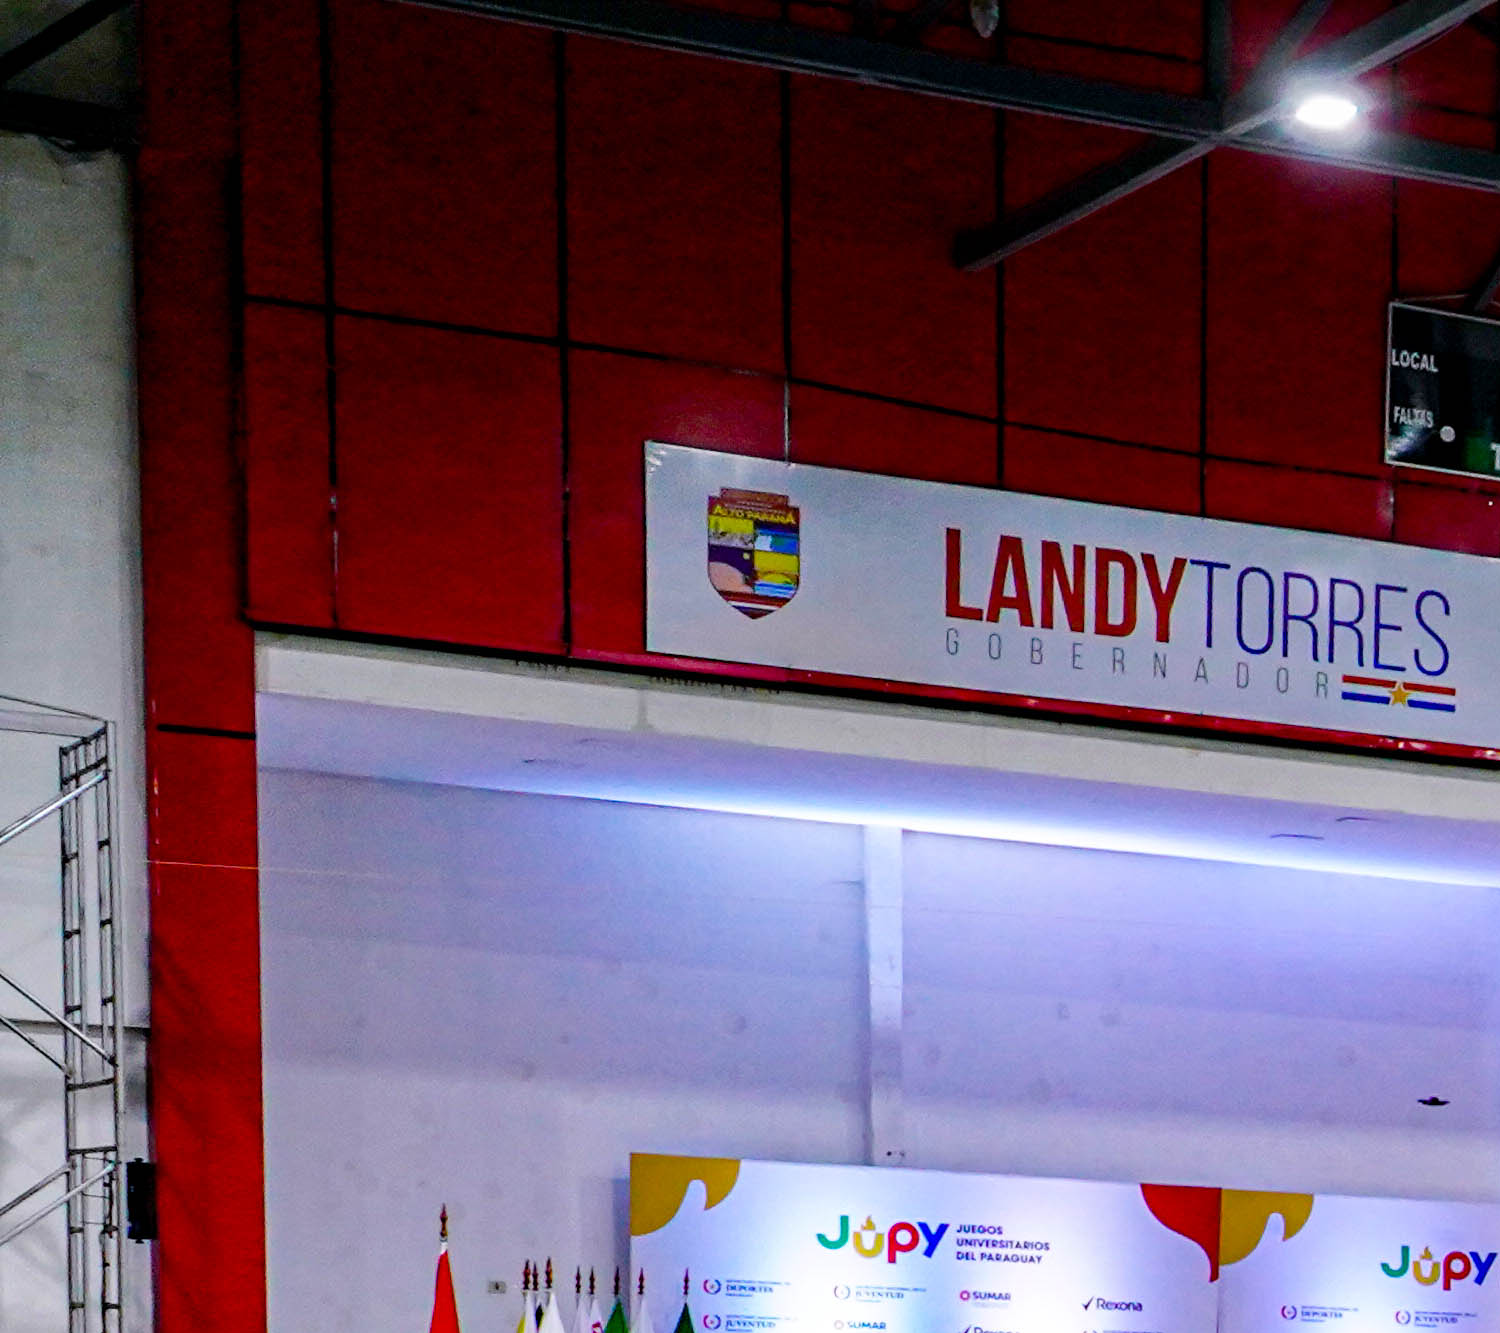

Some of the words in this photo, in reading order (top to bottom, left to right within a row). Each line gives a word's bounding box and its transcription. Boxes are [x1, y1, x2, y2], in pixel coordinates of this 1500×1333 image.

[1391, 349, 1438, 373] LOCAL
[946, 628, 1329, 698] GOBERNADOR
[956, 1224, 1004, 1237] JUEGOS
[956, 1237, 1050, 1253] UNIVERSITARIOS
[956, 1250, 977, 1262] DEL
[979, 1252, 1043, 1266] PARAGUAY
[972, 1291, 1011, 1301] SUMAR
[1096, 1298, 1143, 1312] Rexona
